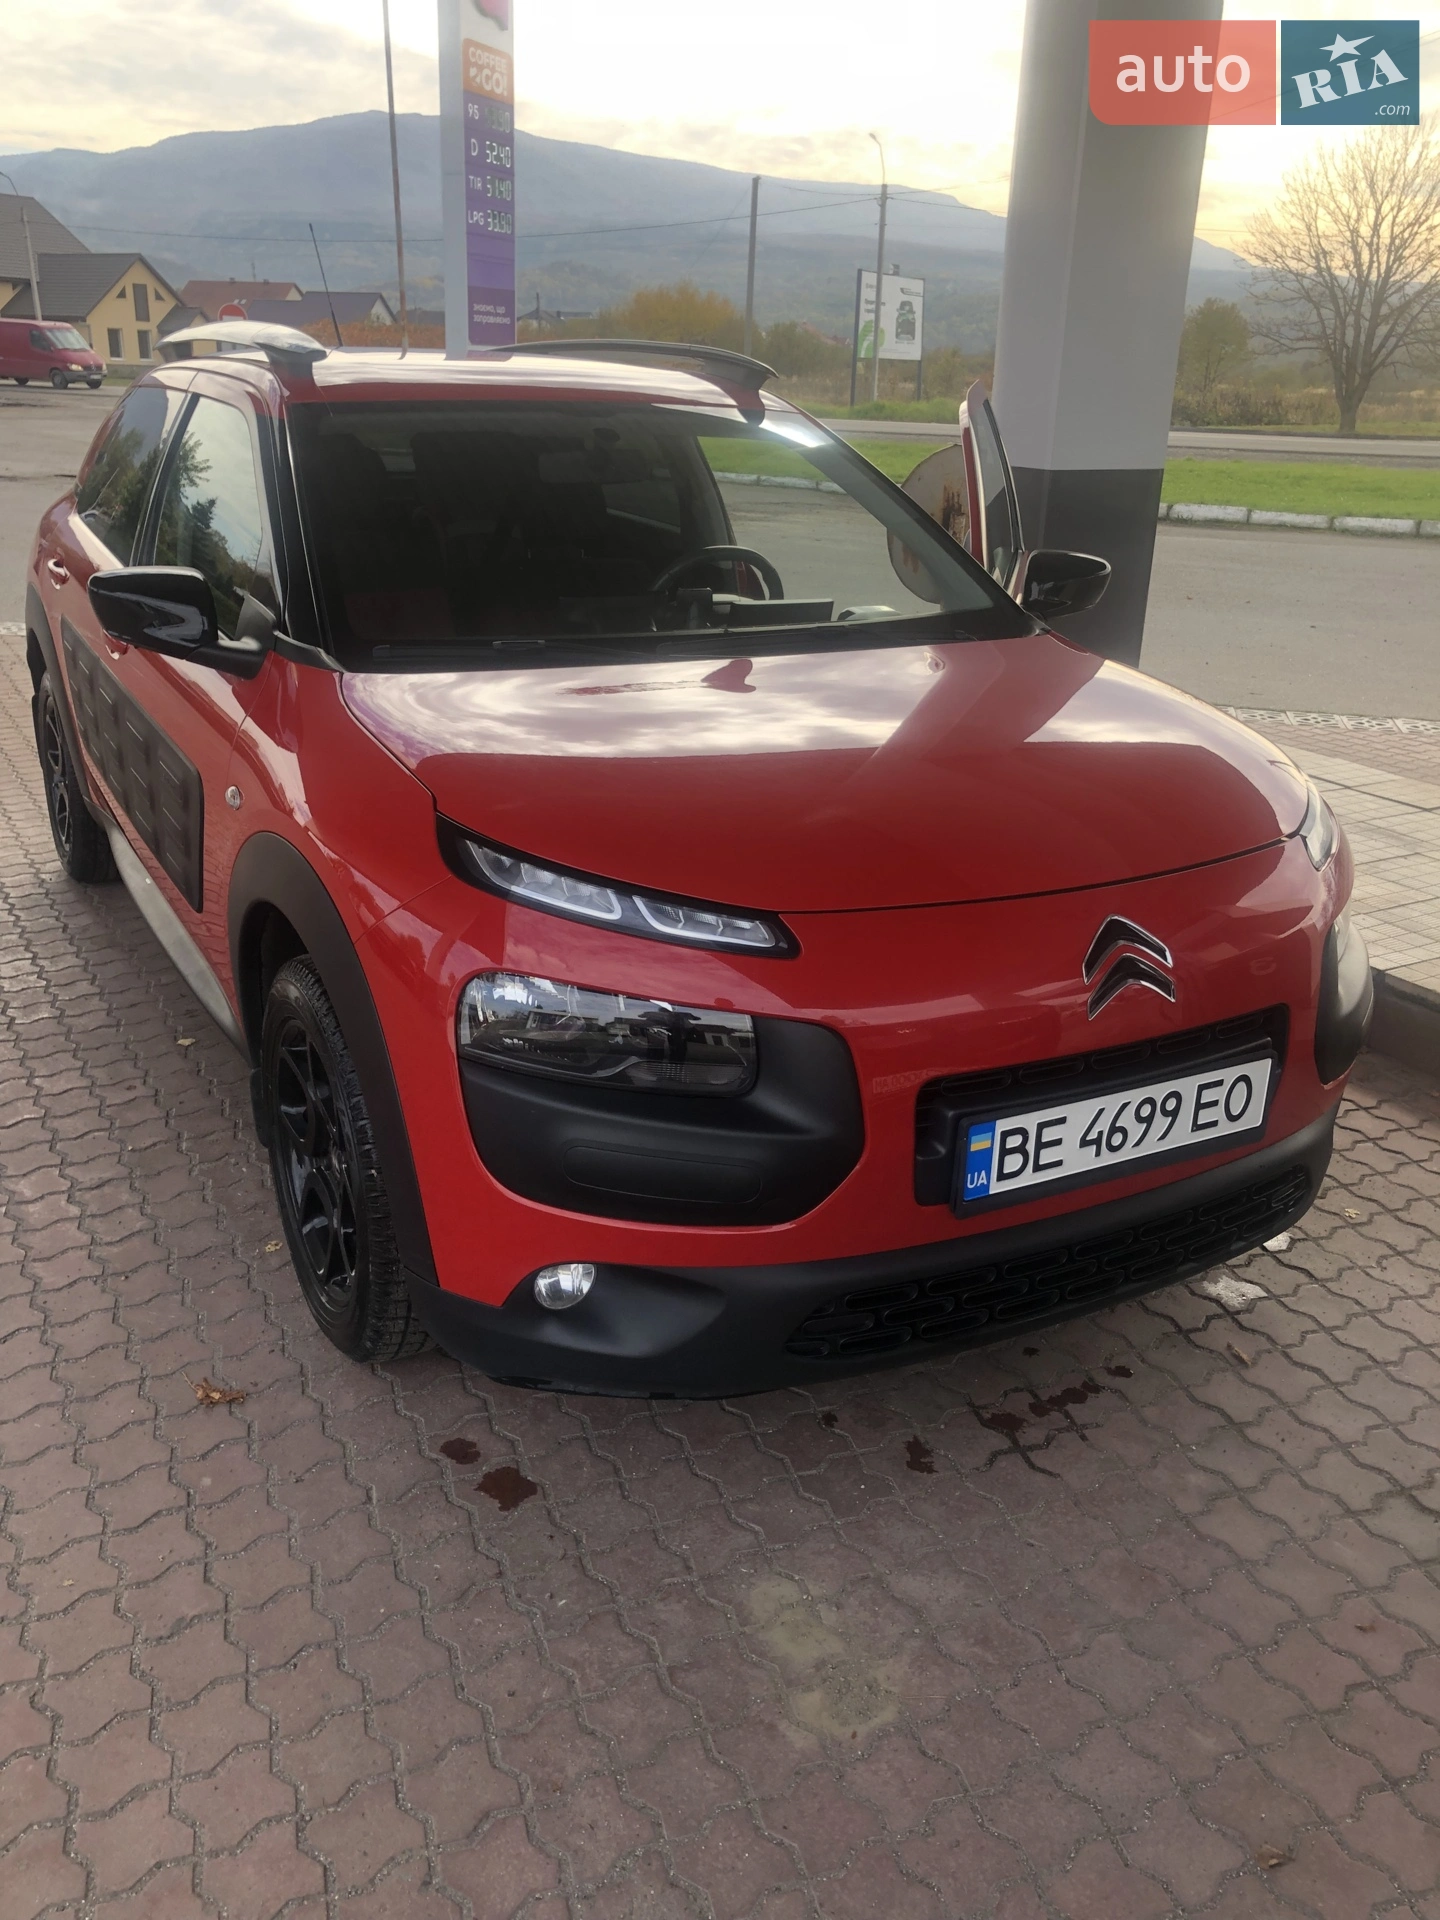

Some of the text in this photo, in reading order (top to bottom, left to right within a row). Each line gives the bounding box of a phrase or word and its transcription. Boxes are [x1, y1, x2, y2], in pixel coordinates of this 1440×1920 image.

[469, 46, 508, 74] COFFEE
[467, 103, 479, 120] 95
[470, 138, 511, 168] D 52.40
[468, 175, 511, 201] TIR 51.40
[467, 210, 484, 226] LPG
[966, 1073, 1253, 1190] UA BE 4699 EO
